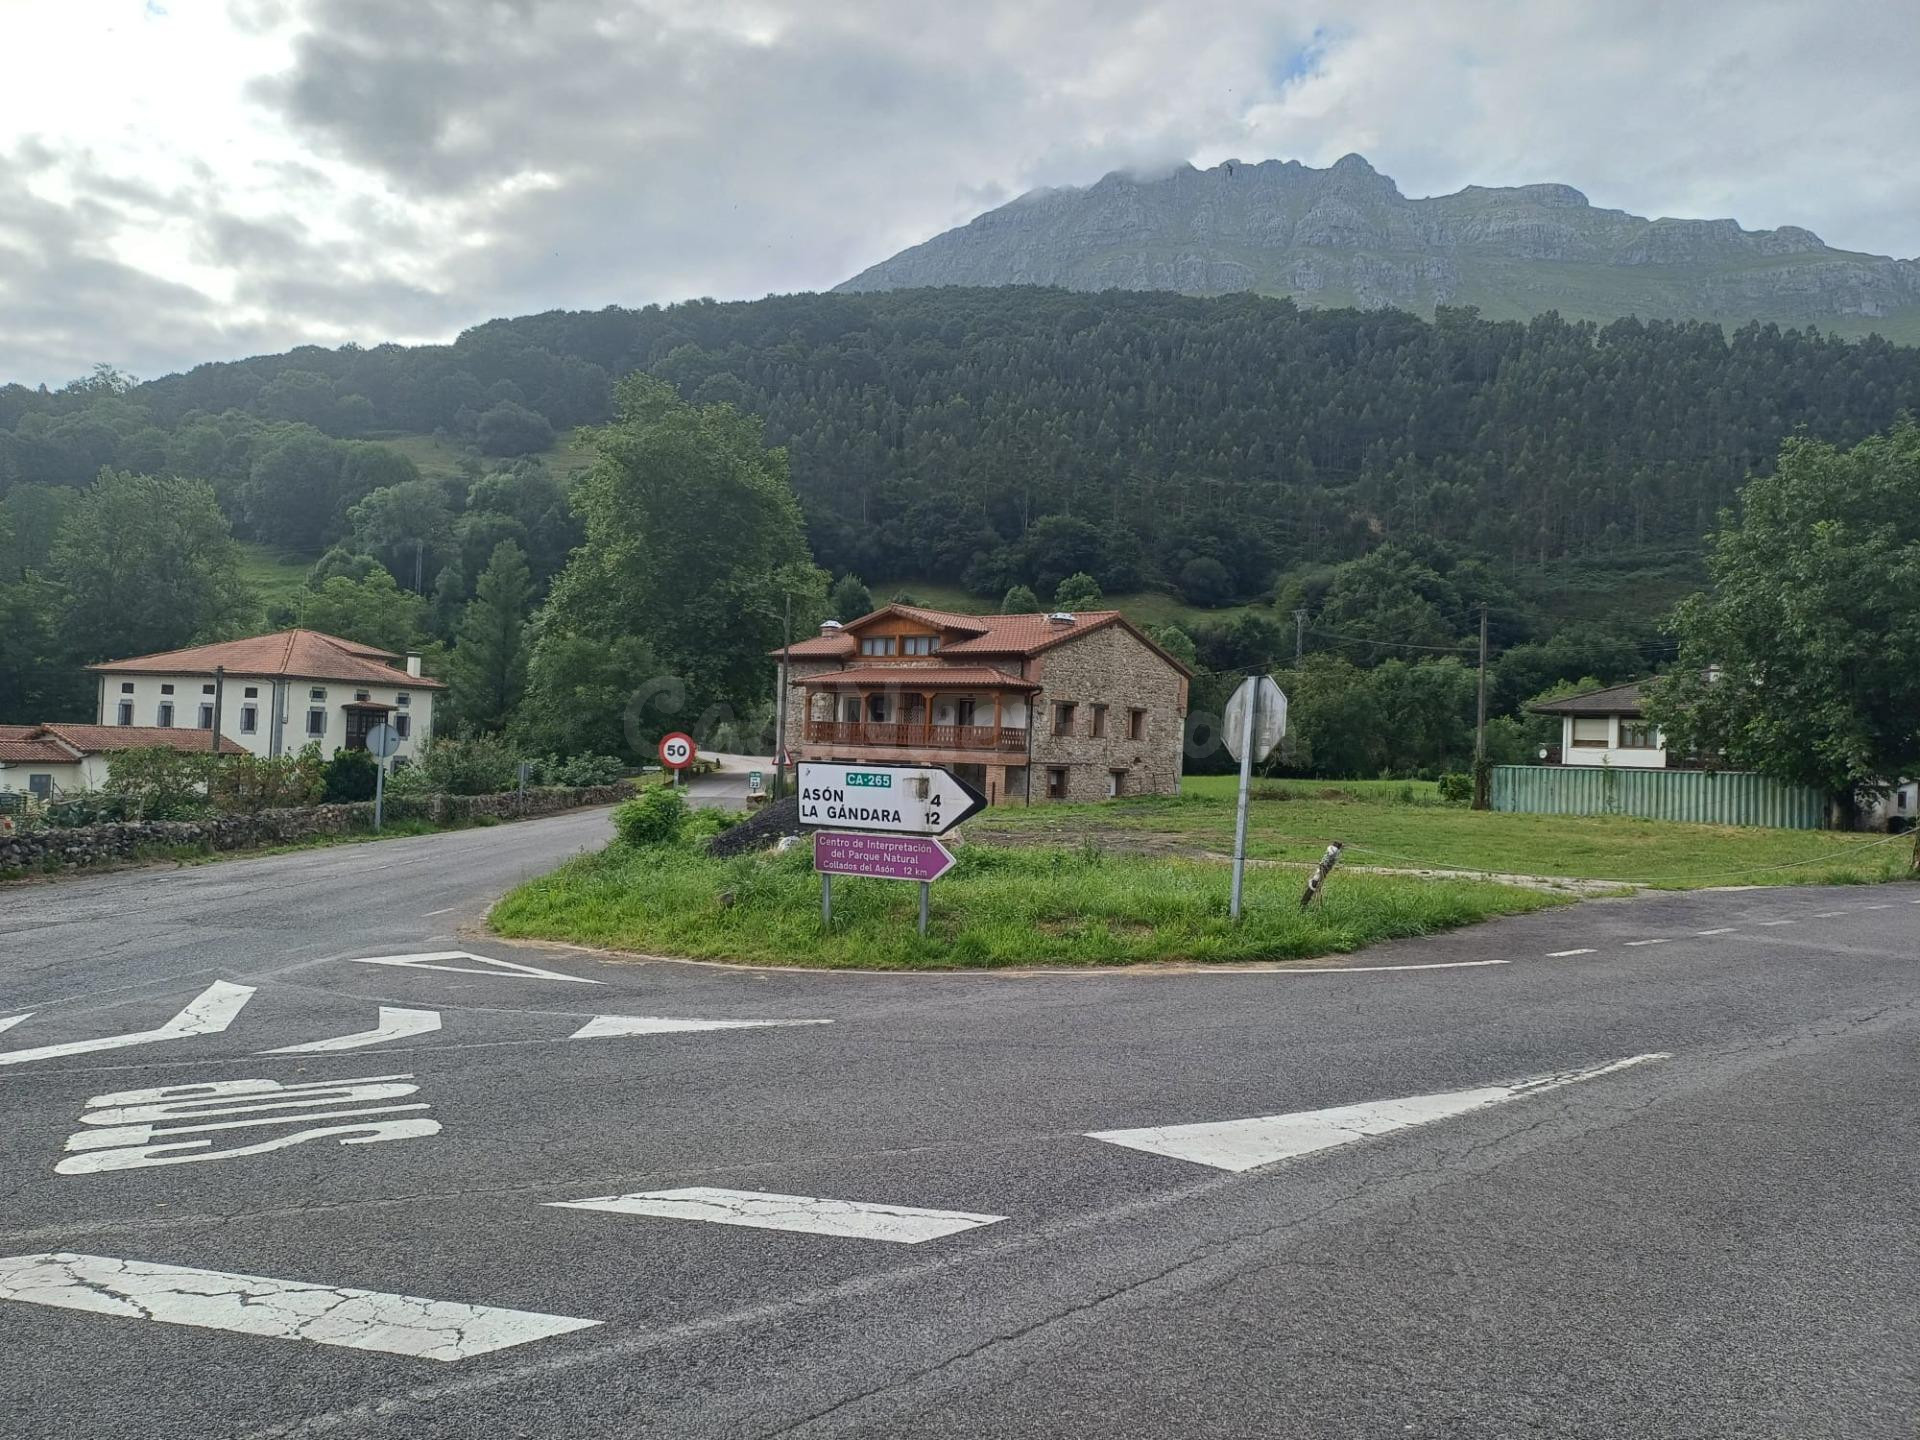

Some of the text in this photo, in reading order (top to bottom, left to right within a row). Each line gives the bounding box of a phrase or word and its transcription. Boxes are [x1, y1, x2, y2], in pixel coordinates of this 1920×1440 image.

[667, 745, 687, 757] 50
[802, 787, 942, 807] ASÓN 4
[802, 805, 941, 825] LA GÁNDARA 12
[819, 836, 932, 854] Centro de Interpretación
[831, 849, 919, 865] del Parque Natural
[823, 860, 928, 876] Collados del Asón 12 km
[54, 1073, 443, 1175] STOP
